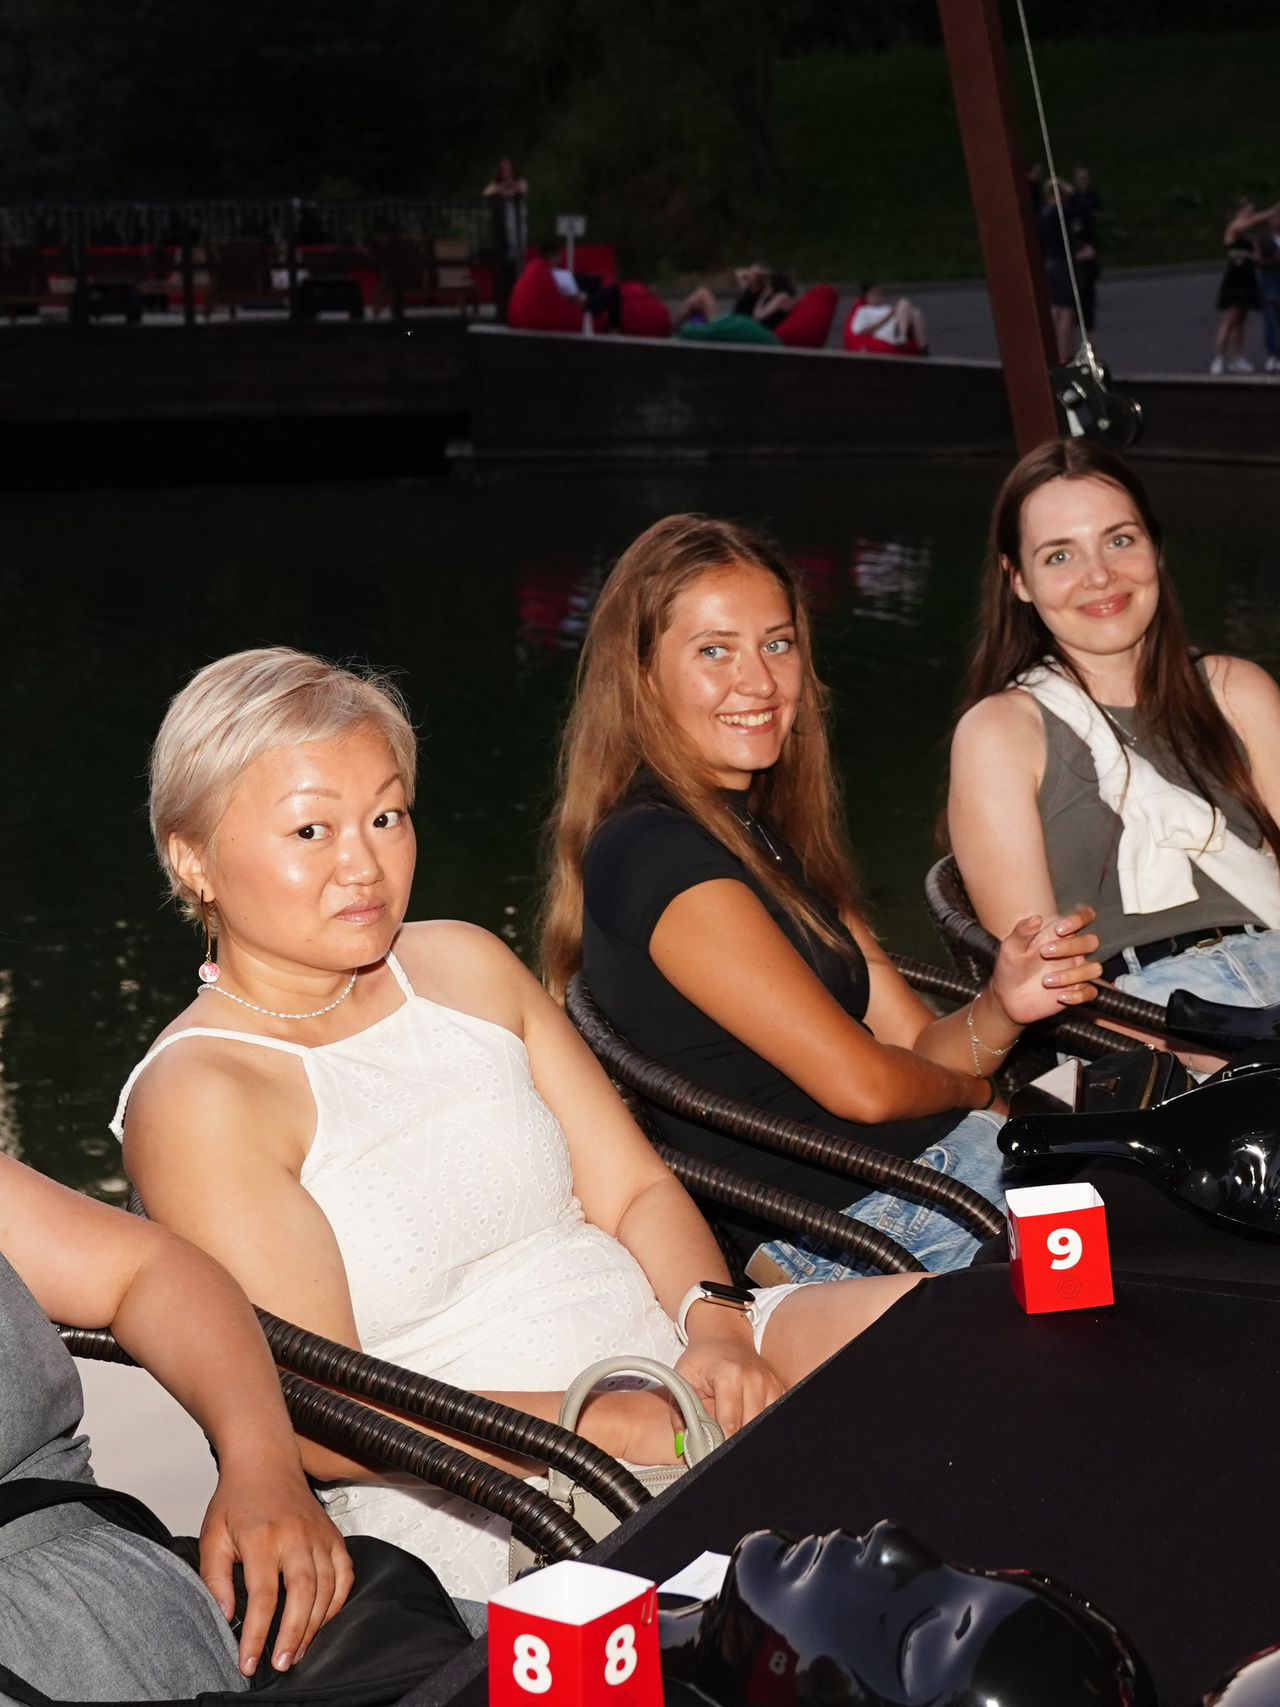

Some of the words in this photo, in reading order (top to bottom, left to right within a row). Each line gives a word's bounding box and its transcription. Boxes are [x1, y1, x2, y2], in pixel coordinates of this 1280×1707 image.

[1046, 1227, 1083, 1271] 9
[512, 1633, 553, 1694] 8
[604, 1624, 638, 1686] 8
